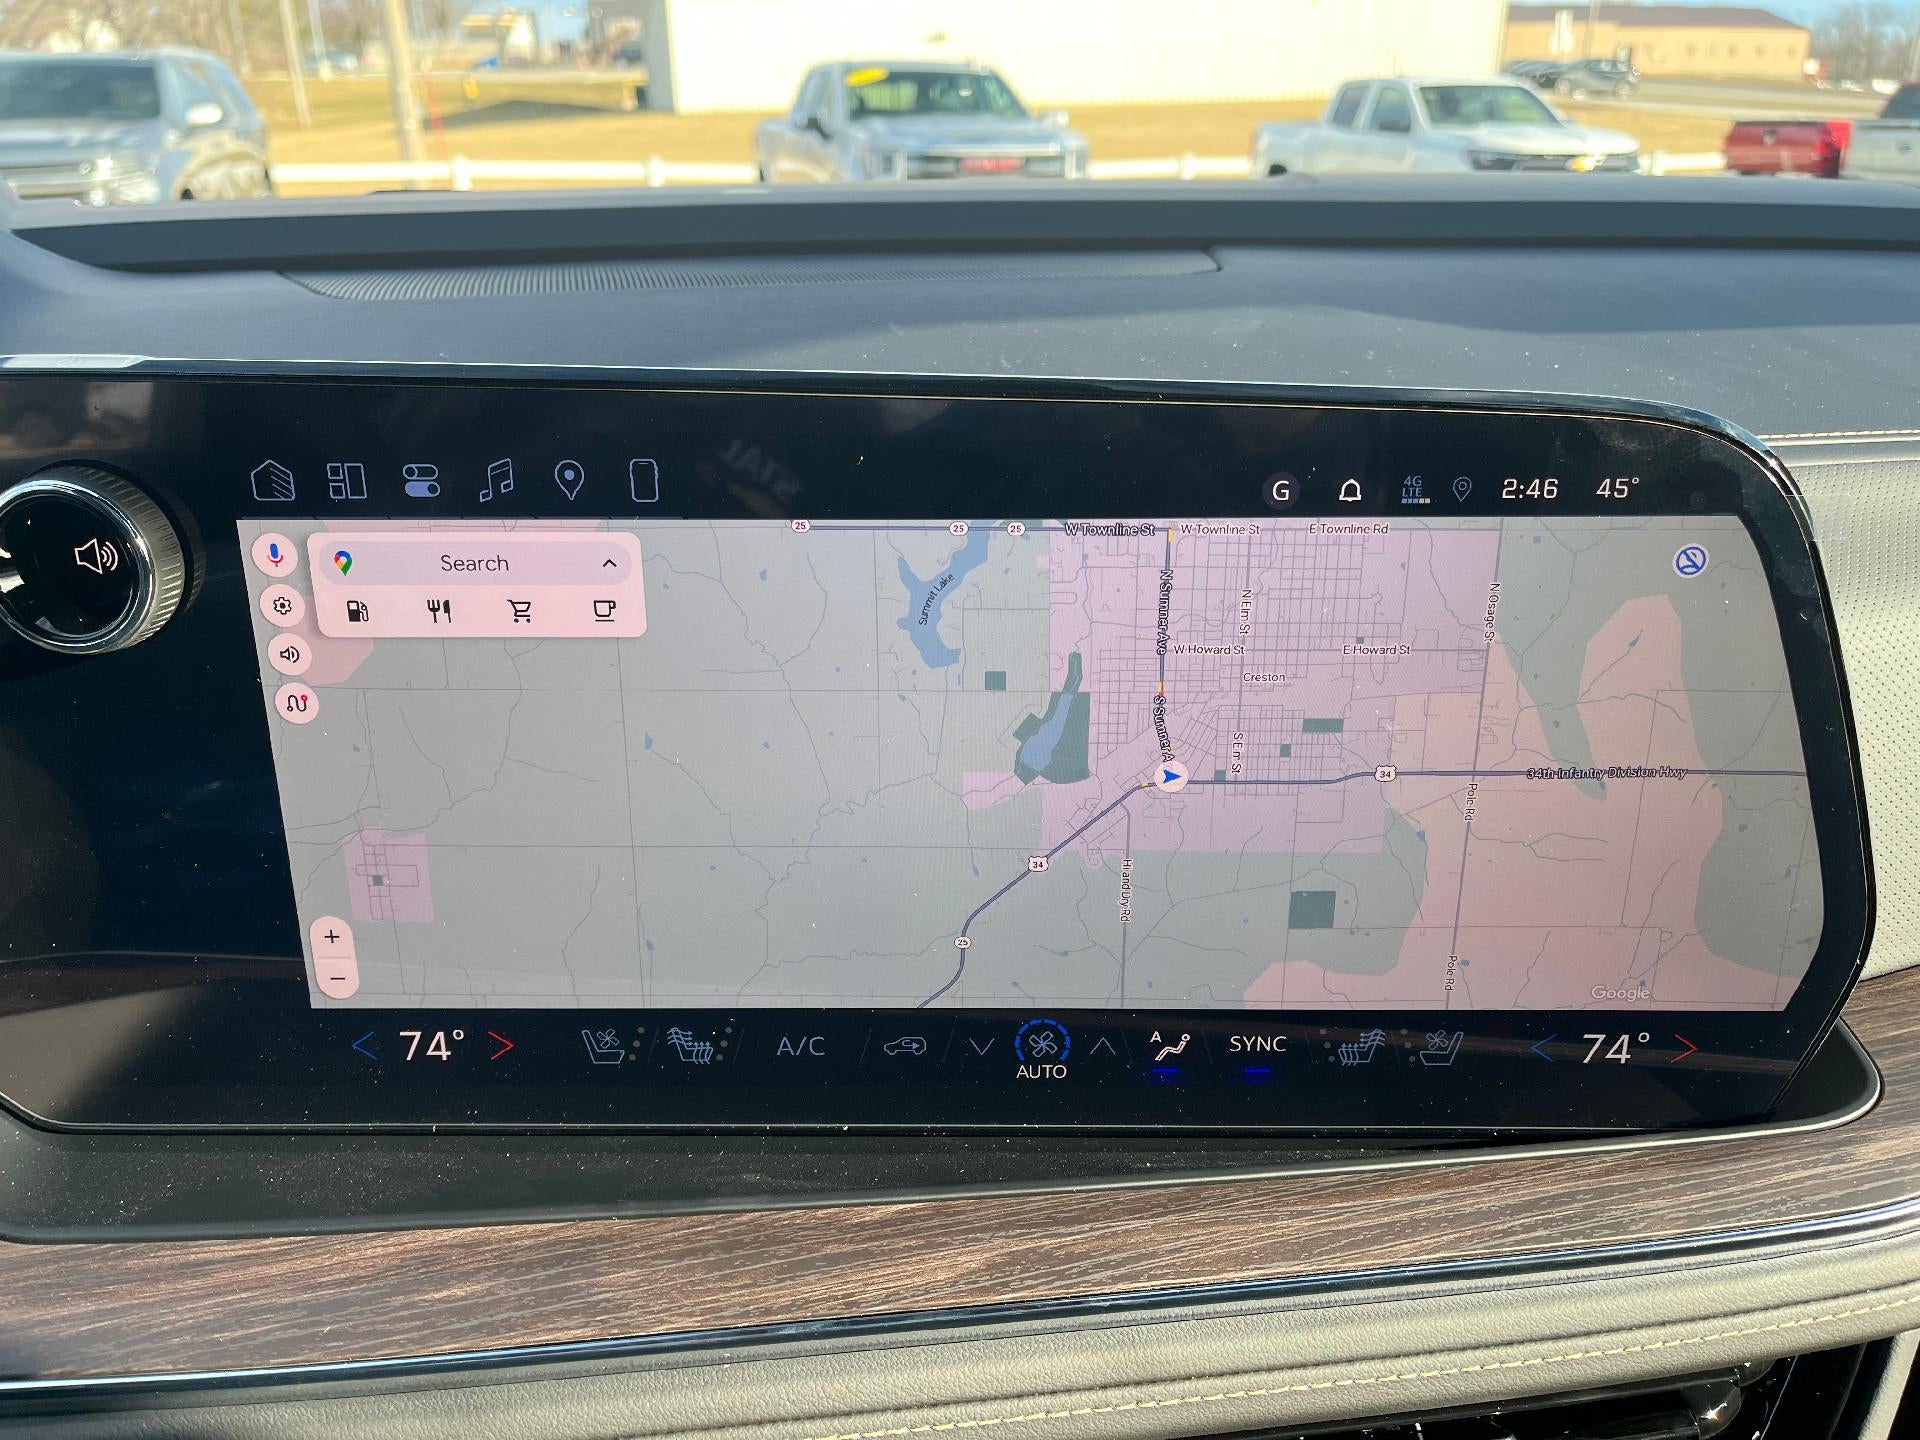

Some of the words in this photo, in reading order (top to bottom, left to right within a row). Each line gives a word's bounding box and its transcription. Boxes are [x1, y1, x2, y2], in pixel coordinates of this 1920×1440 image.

[1403, 475, 1422, 486] 4G
[1271, 480, 1291, 501] G
[1402, 487, 1422, 497] LTE
[1502, 478, 1559, 500] 2:46
[1596, 476, 1639, 499] 45°
[795, 522, 806, 530] 25
[954, 524, 964, 533] 25
[1010, 524, 1022, 533] 25
[1064, 523, 1078, 536] W
[1080, 523, 1138, 536] Townline
[1140, 523, 1155, 536] St
[1181, 524, 1192, 534] W
[1196, 524, 1245, 535] Townline
[1248, 524, 1260, 535] St
[1310, 524, 1317, 534] E
[1318, 524, 1370, 534] Townline
[1372, 524, 1388, 534] Rd
[440, 554, 509, 573] Search
[1160, 570, 1173, 580] N
[1242, 589, 1252, 598] N
[1490, 583, 1500, 592] N
[919, 591, 938, 625] Summit
[934, 573, 955, 592] Lake
[1158, 582, 1172, 630] Sumner
[1241, 601, 1252, 621] Elm
[1484, 595, 1499, 628] Osage
[1240, 624, 1251, 635] St
[1484, 631, 1494, 642] St
[1157, 632, 1170, 655] Ave
[1173, 645, 1185, 654] W
[1187, 645, 1231, 655] Howard
[1233, 645, 1244, 655] St
[1343, 645, 1350, 655] E
[1352, 645, 1396, 655] Howard
[1398, 645, 1411, 655] St
[1243, 672, 1286, 682] Creston
[1154, 696, 1166, 705] S
[1154, 707, 1171, 751] Sumner
[1234, 732, 1243, 740] S
[1232, 742, 1243, 761] Em
[1231, 763, 1241, 774] St
[1378, 770, 1392, 779] 34
[1527, 767, 1555, 779] 34th
[1557, 767, 1605, 781] Infantry
[1608, 767, 1657, 779] Division
[1659, 767, 1688, 780] Hwy
[1467, 783, 1478, 805] Pole
[1465, 809, 1475, 821] Rd
[1122, 872, 1131, 890] and
[1119, 891, 1130, 907] Dry
[1120, 909, 1130, 922] Rd
[1446, 955, 1458, 975] Pole
[1445, 979, 1454, 990] Rd
[1591, 985, 1650, 1002] Google
[399, 1029, 465, 1061] 74°
[776, 1036, 826, 1056] A/C
[1229, 1035, 1287, 1053] SYNC
[1582, 1032, 1651, 1064] 74°
[1016, 1064, 1067, 1079] AUTO
